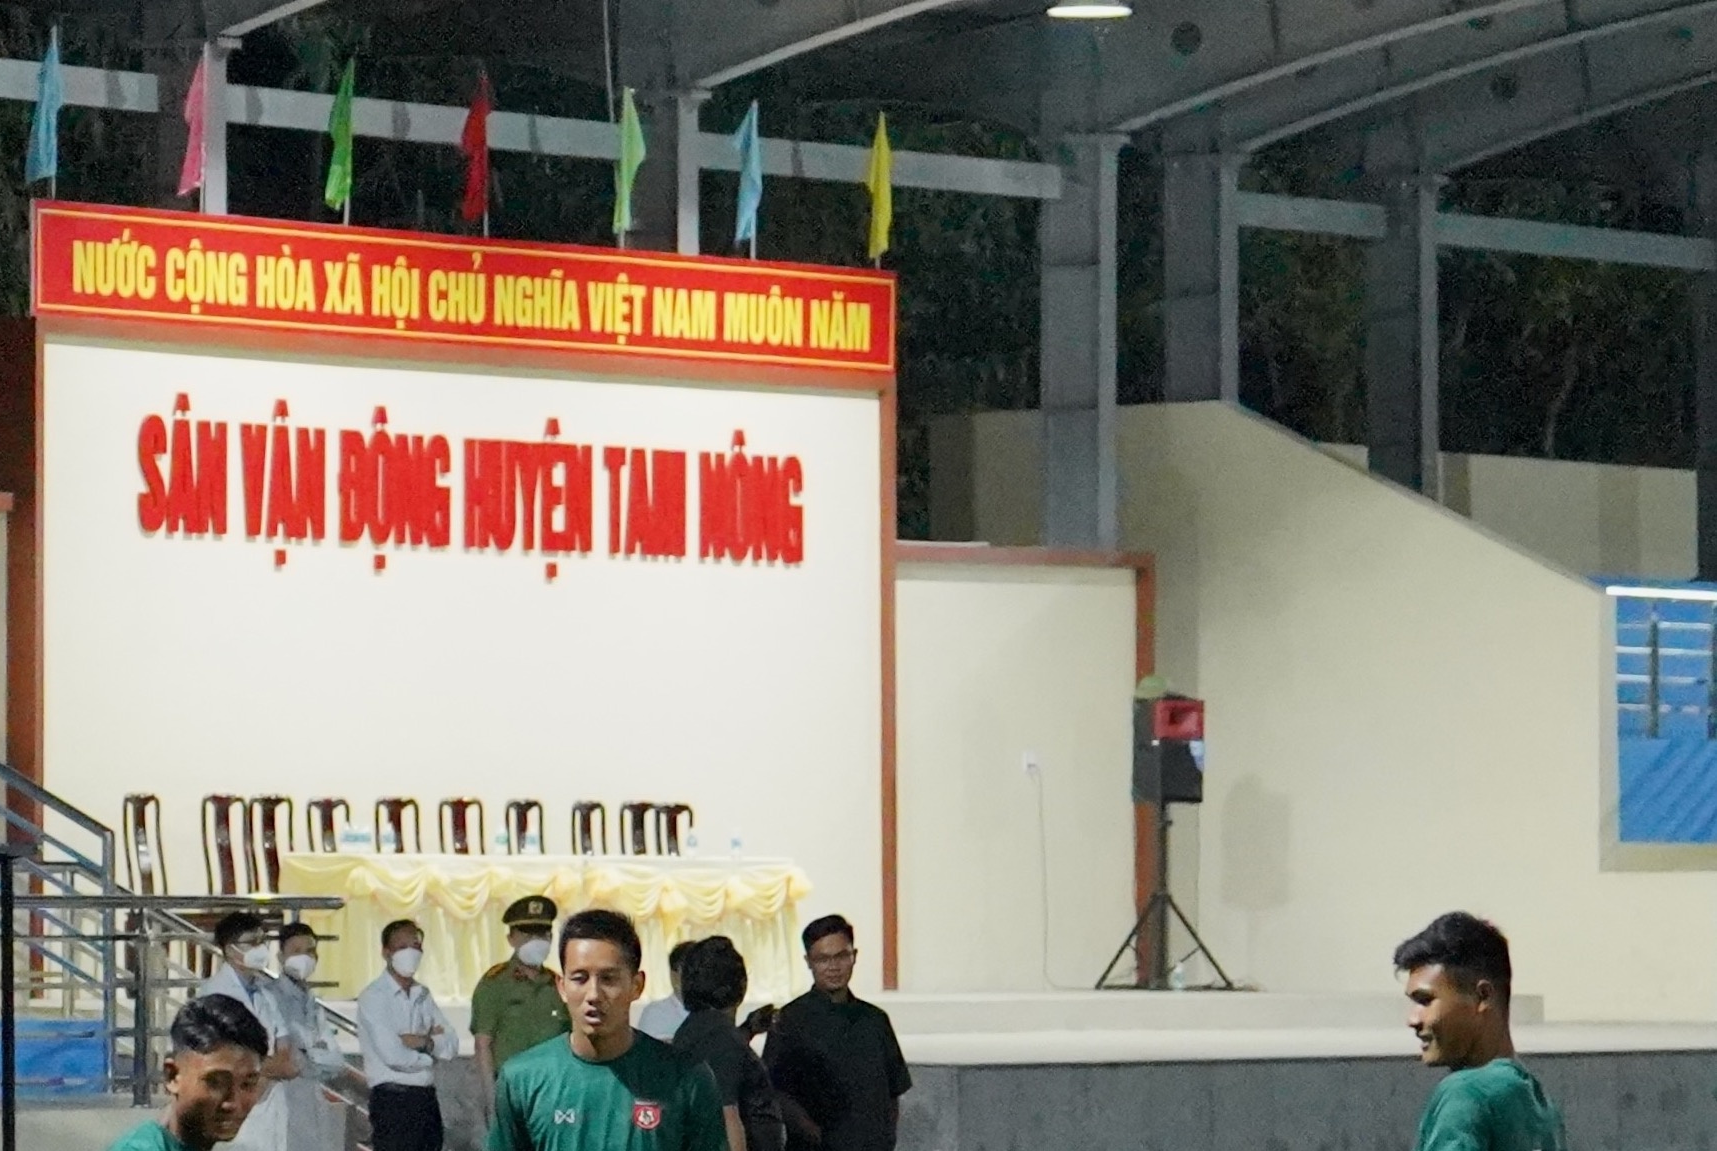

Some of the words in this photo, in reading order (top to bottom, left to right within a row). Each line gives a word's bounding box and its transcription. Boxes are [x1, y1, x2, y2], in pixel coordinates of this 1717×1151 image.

[72, 228, 157, 300] NƯỚC
[165, 238, 249, 315] CỘNG
[255, 244, 316, 312] HÒA
[323, 252, 364, 316] XÃ
[370, 255, 420, 330] HỘI
[428, 251, 486, 325] CHỦ
[493, 268, 582, 332] NGHĨA
[587, 272, 647, 345] VIỆT
[652, 286, 717, 341] NAM
[722, 284, 804, 348] MUÔN
[809, 290, 871, 353] NĂM
[137, 392, 228, 536] SÂN
[240, 398, 326, 566] VẬN
[338, 405, 451, 571] ĐỘNG
[463, 417, 593, 579] HUYỆN
[603, 446, 687, 557] TAM
[699, 429, 804, 564] NÔNG
